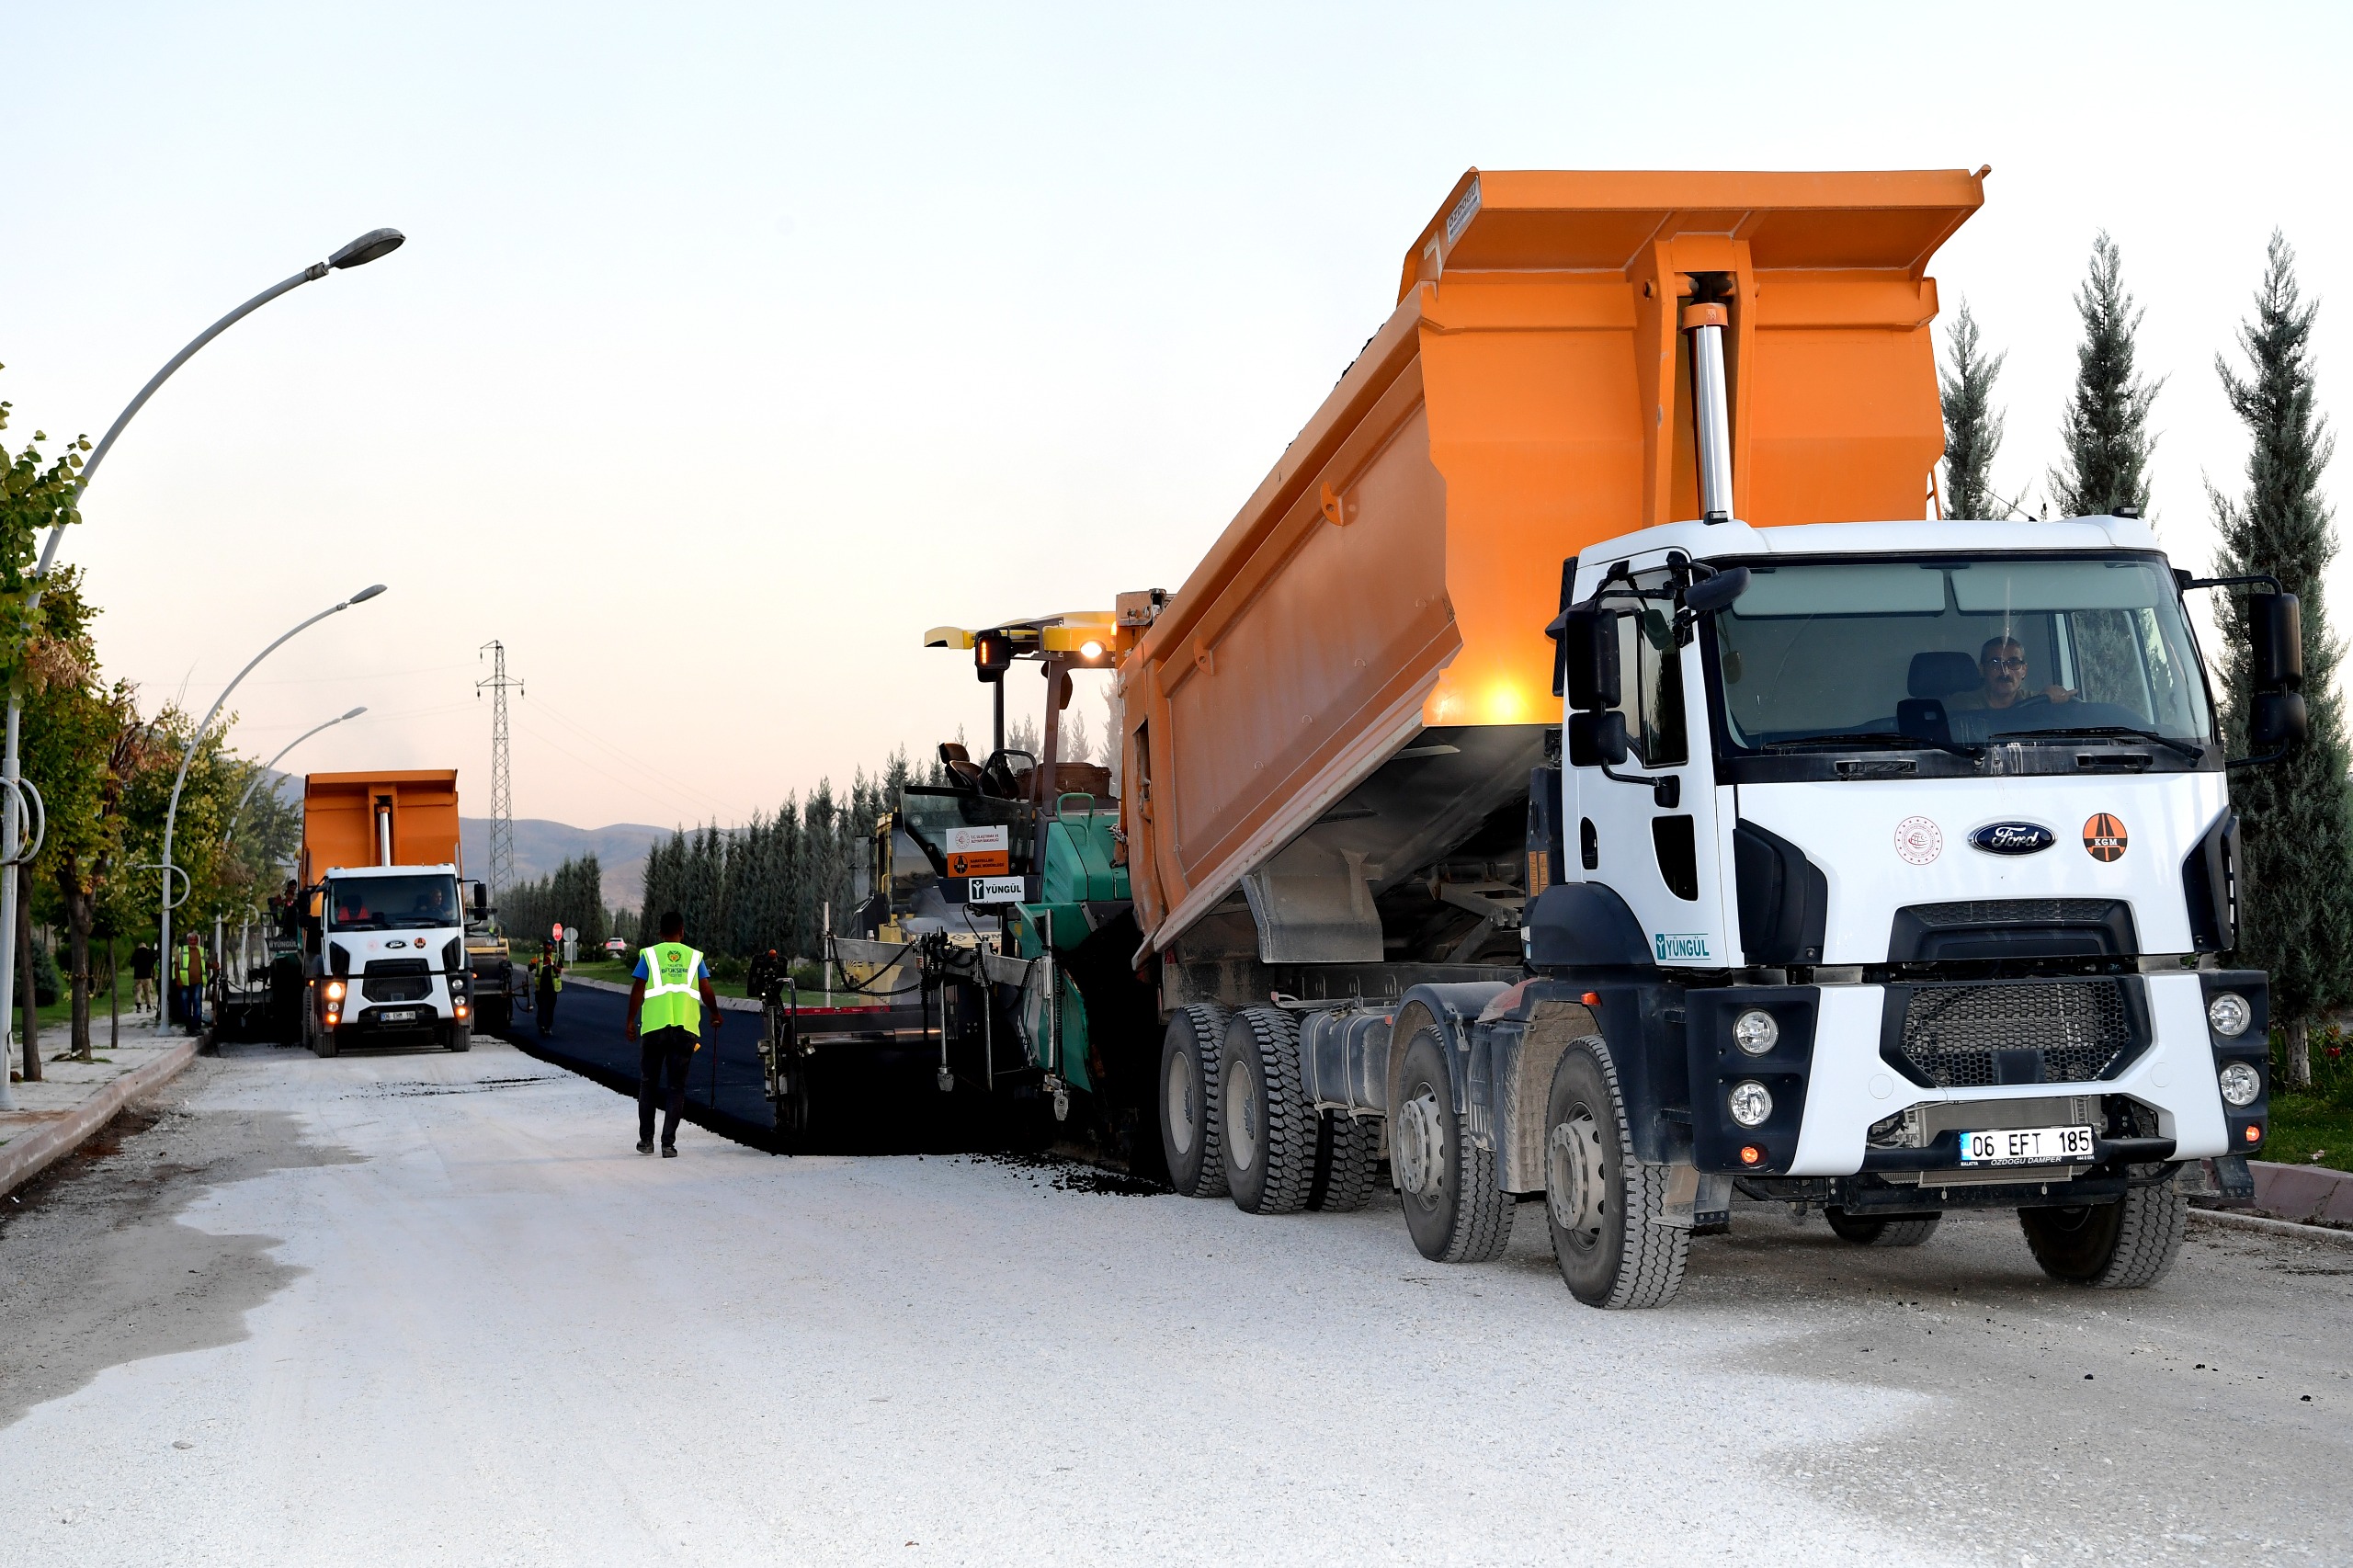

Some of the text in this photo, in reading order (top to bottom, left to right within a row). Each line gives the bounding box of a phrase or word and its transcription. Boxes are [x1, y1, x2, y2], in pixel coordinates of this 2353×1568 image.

[1991, 826, 2040, 847] Ford
[2094, 837, 2119, 846] KGM
[985, 882, 1022, 894] YÜNGÜL
[1666, 936, 1710, 957] YÜNGÜL
[1972, 1131, 2089, 1157] 06 EFT 185
[2027, 1156, 2062, 1165] DAMPER
